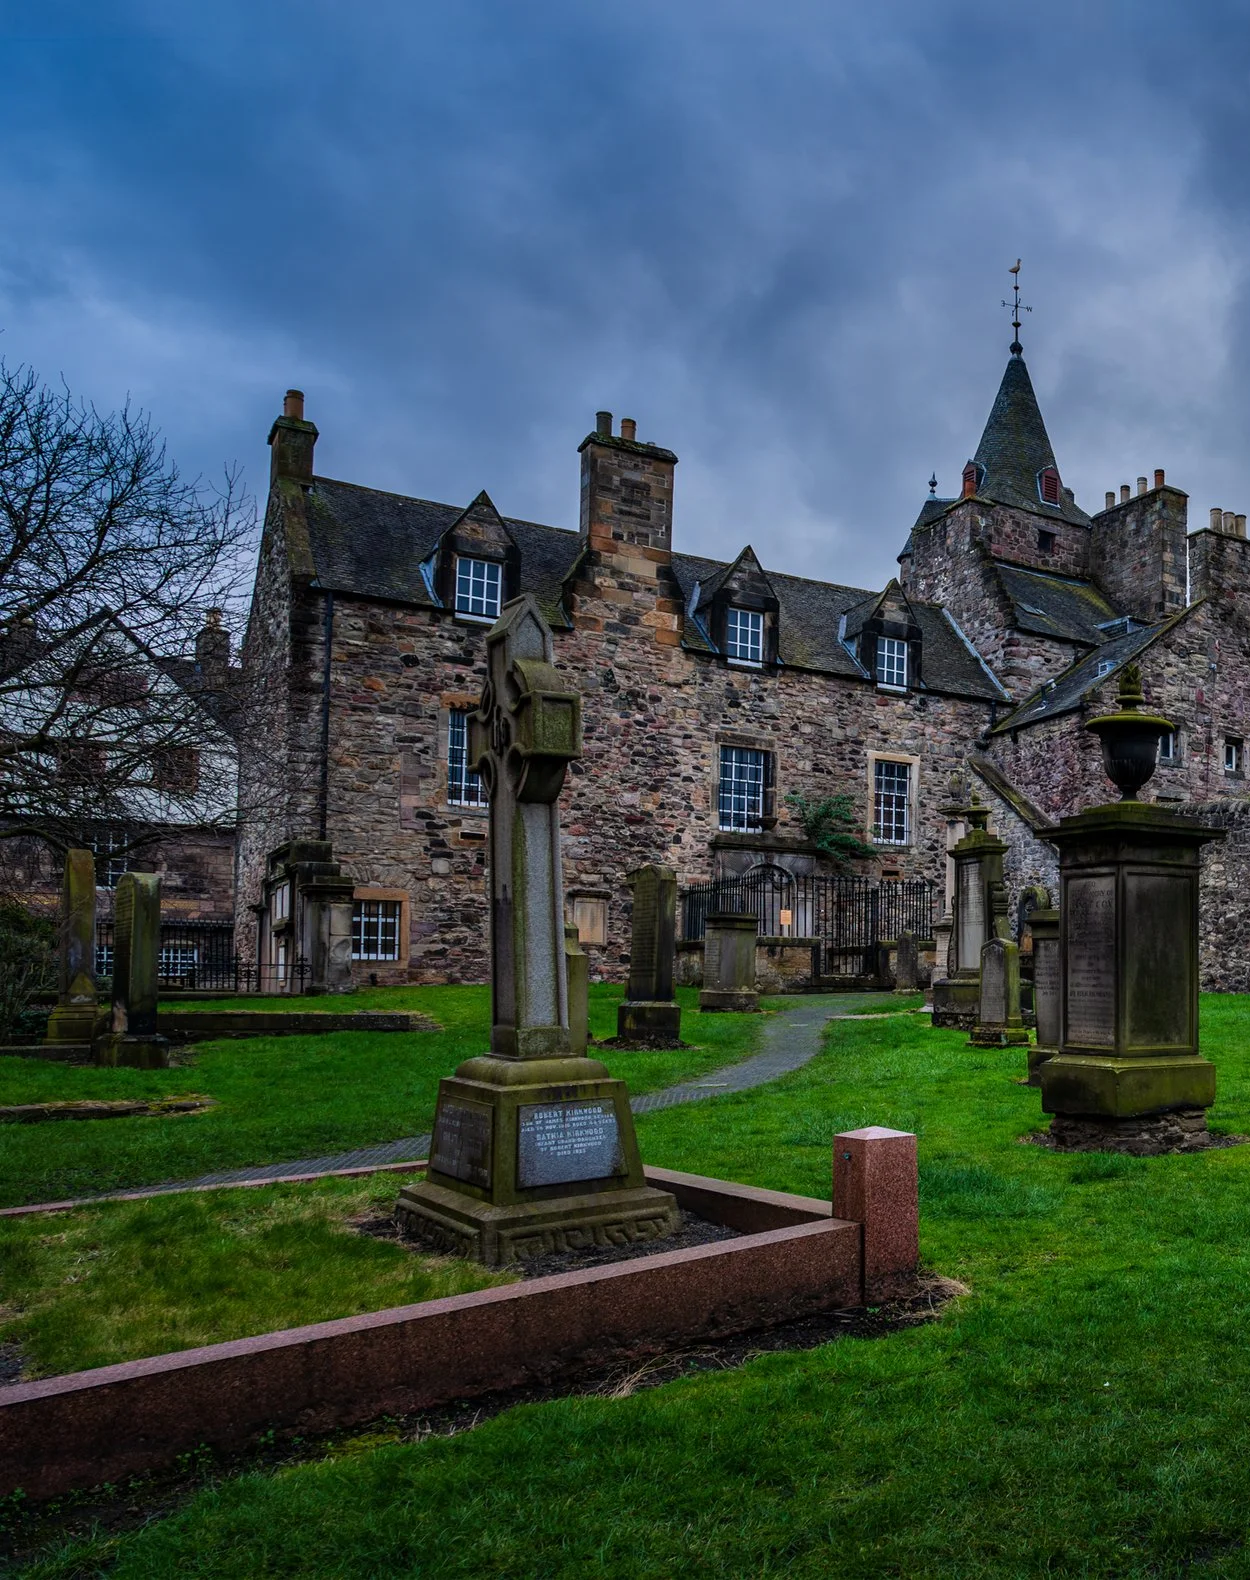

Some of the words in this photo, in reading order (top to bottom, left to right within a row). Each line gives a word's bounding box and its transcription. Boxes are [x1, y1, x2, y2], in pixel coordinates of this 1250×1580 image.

[534, 1110, 563, 1120] ROBERT
[566, 1106, 602, 1116] KIRKWOOD
[566, 1128, 604, 1138] KIRKWOOD
